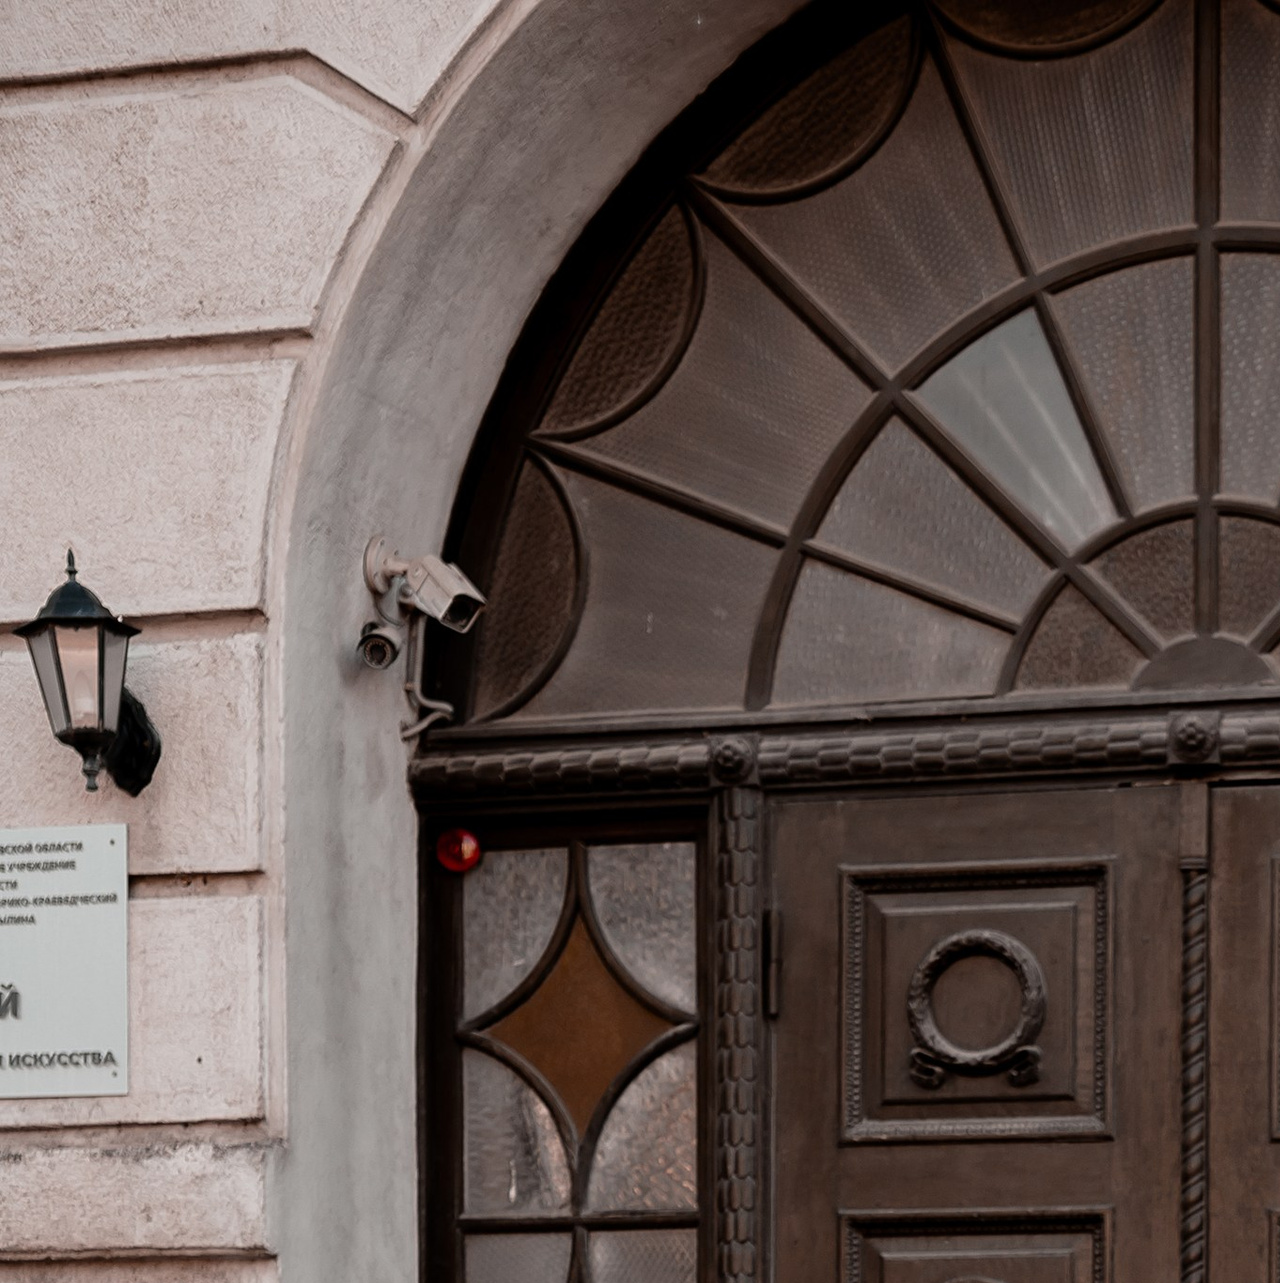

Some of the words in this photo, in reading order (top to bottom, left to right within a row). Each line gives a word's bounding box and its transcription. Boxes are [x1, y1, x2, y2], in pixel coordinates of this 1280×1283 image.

[35, 841, 83, 853] ОБЛАСТИ
[7, 861, 76, 873] УЧРЕЖДЕНИЕ
[9, 1051, 118, 1069] ИСКУССТВА
